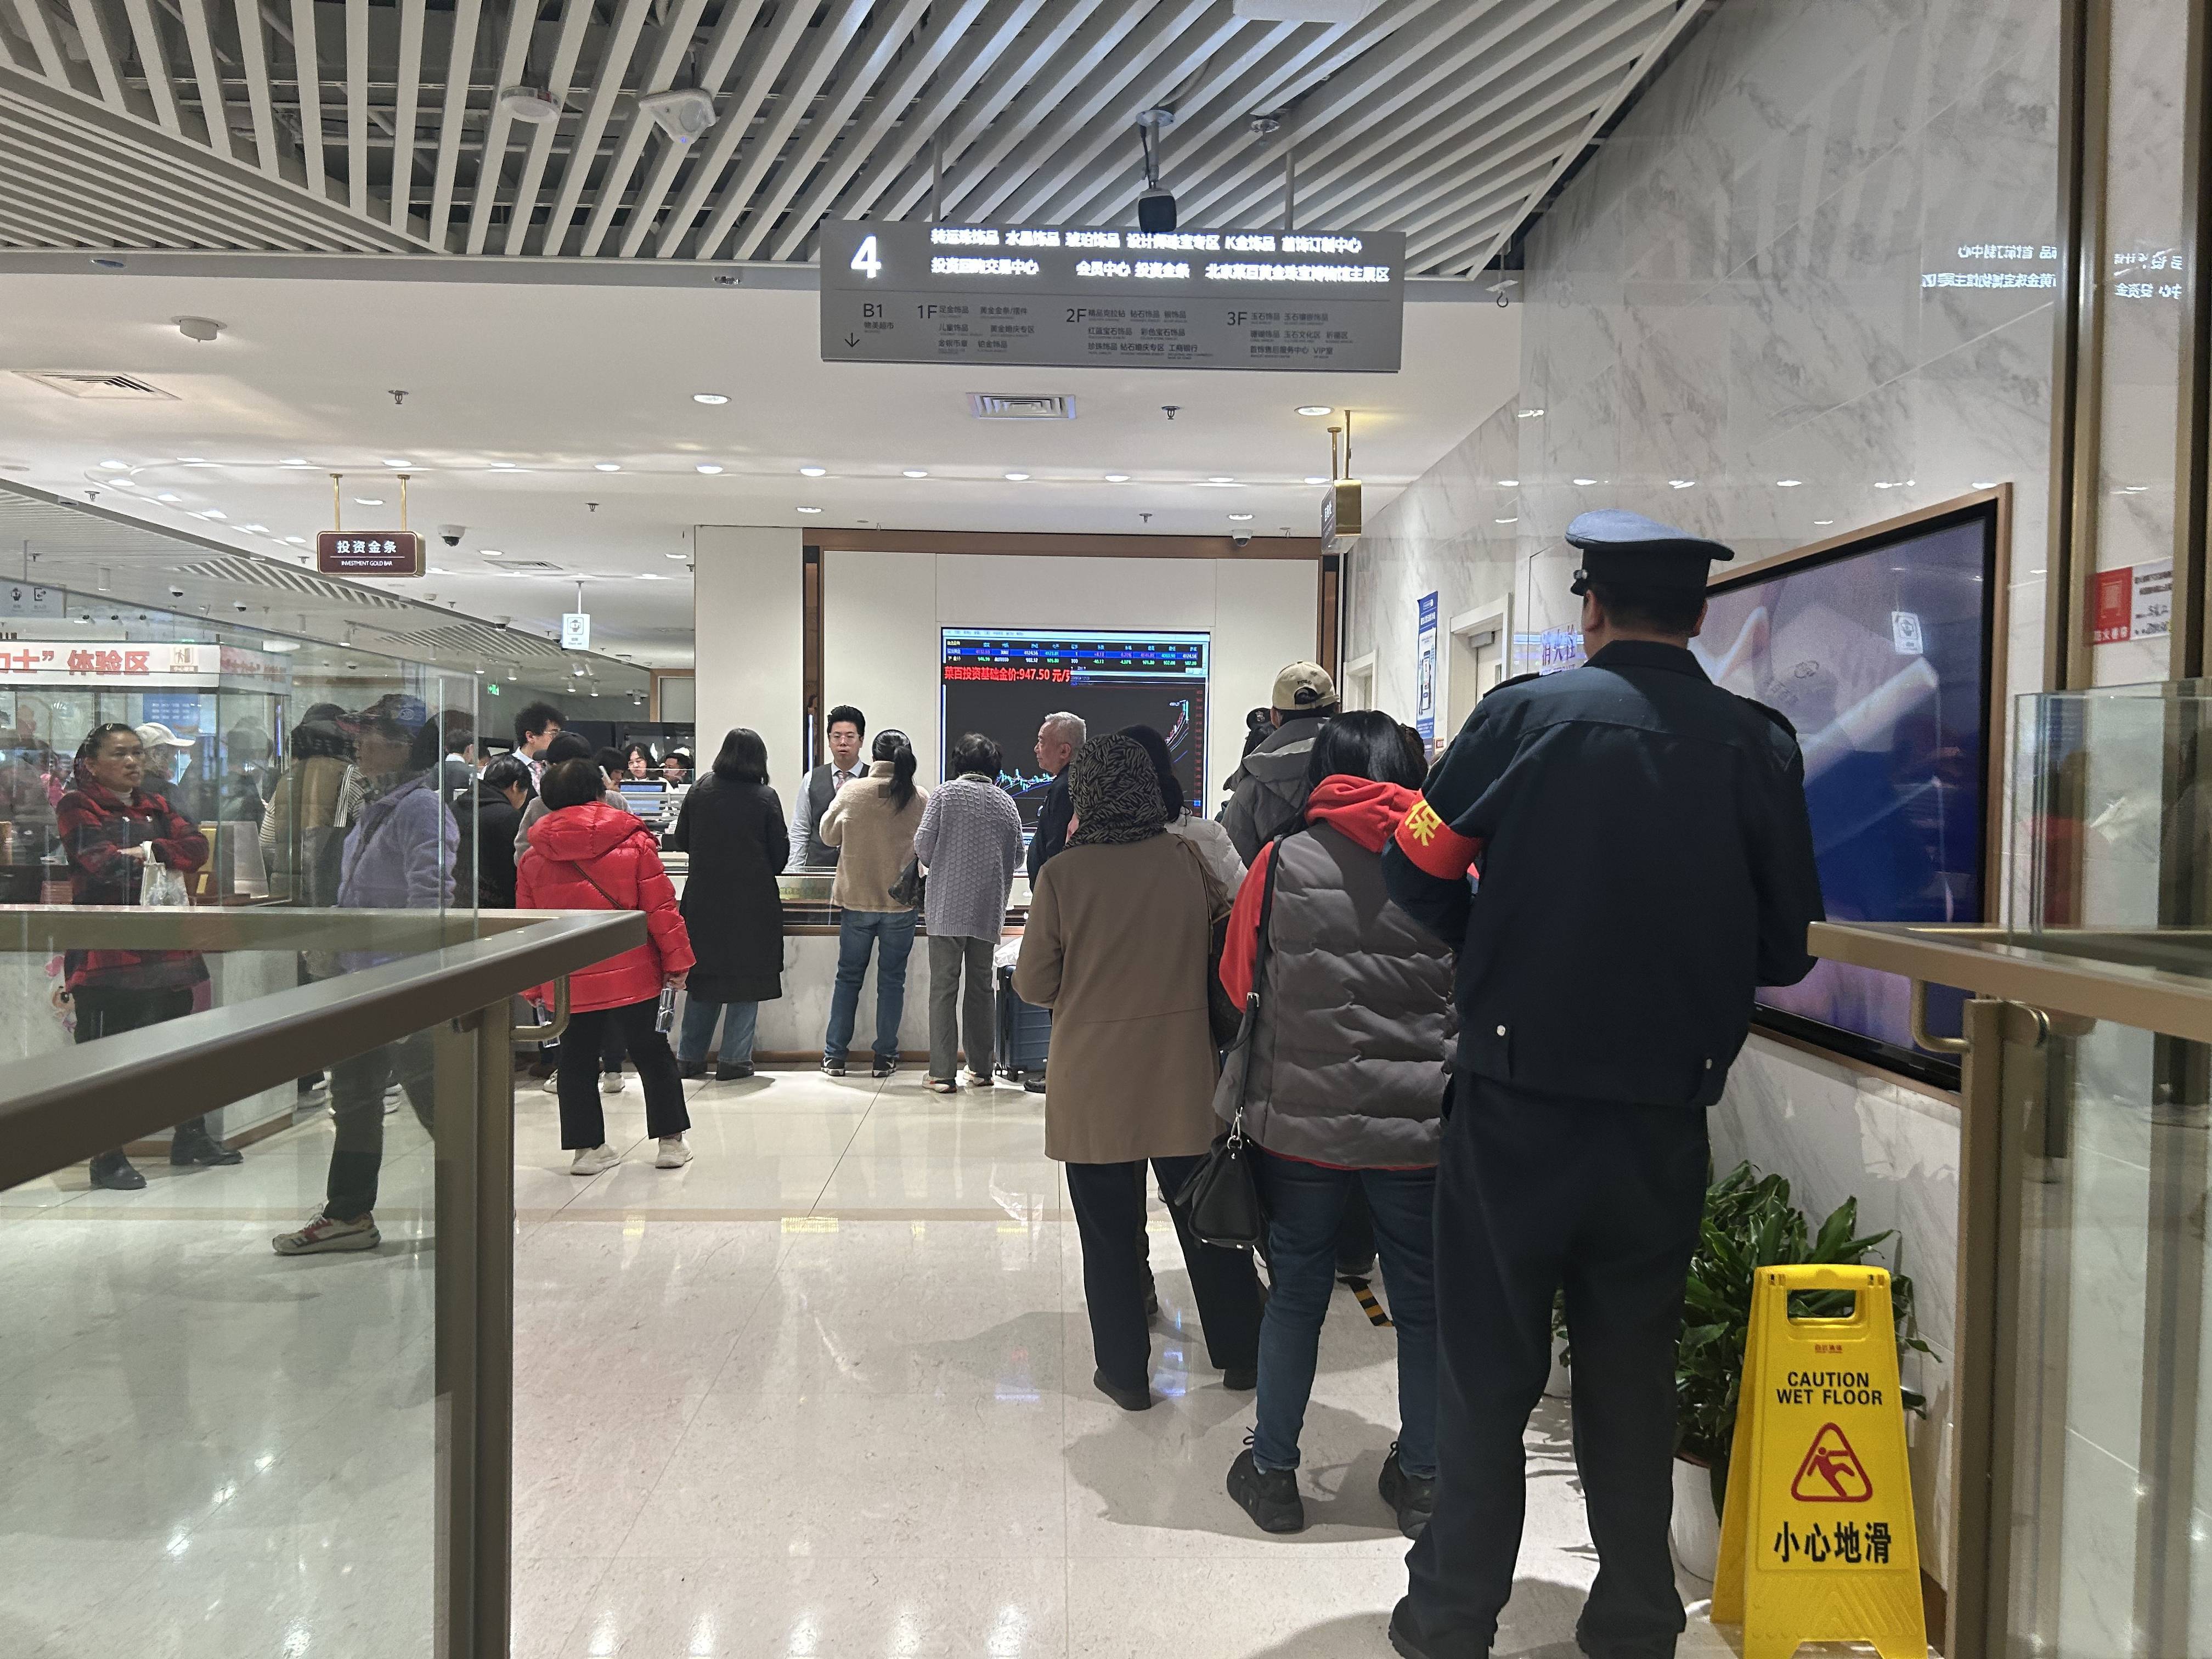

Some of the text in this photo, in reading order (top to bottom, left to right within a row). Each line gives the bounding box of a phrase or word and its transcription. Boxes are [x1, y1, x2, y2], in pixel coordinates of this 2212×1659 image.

[1005, 230, 1060, 246] 水晶饰品
[1224, 234, 1276, 251] K金饰品
[850, 233, 882, 278] 4
[1076, 259, 1131, 276] 会员中心
[1135, 261, 1189, 279] 投资金条
[863, 303, 883, 318] B1
[918, 305, 938, 319] 1F
[1066, 308, 1086, 323] 2F
[1227, 312, 1247, 326] 3F
[336, 540, 397, 554] 投资金条
[67, 650, 150, 676] 体验区
[945, 666, 1050, 681] 菜百投资基础金价:947.50
[1404, 799, 1443, 847] 保
[1787, 1371, 1869, 1387] CAUTION
[1776, 1389, 1883, 1406] WET FLOOR
[1774, 1521, 1892, 1564] 小心地滑
